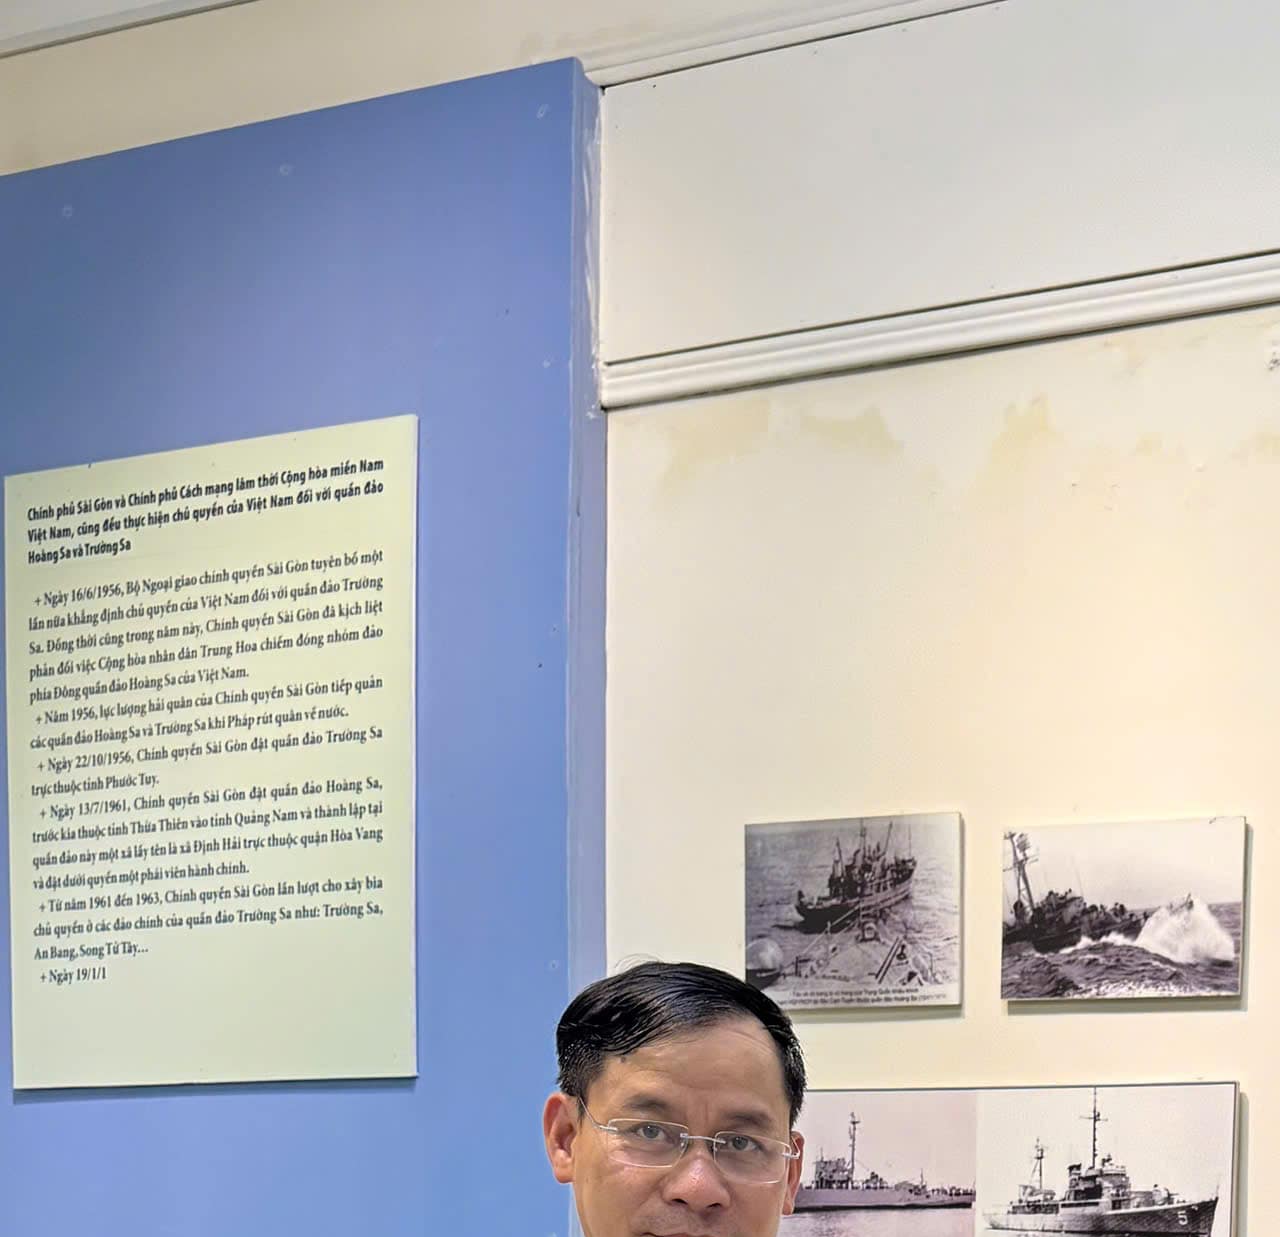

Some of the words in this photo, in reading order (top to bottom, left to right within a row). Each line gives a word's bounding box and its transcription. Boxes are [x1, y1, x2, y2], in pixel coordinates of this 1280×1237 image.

[28, 505, 54, 520] Chính
[57, 501, 75, 519] phủ
[77, 500, 92, 514] Sài
[94, 497, 112, 510] Gòn
[115, 494, 125, 508] và
[129, 491, 156, 506] Chính
[159, 486, 177, 504] phủ
[180, 483, 202, 498] Cách
[206, 482, 233, 497] mạng
[236, 477, 255, 491] lâm
[258, 474, 278, 488] thời
[281, 471, 305, 487] Cộng
[309, 466, 328, 479] hòa
[331, 461, 356, 476] miền
[360, 460, 383, 472] Nam
[28, 528, 46, 545] Việt
[50, 526, 74, 539] Nam,
[78, 521, 99, 536] cũng
[103, 518, 120, 532] đều
[124, 515, 146, 531] thực
[148, 512, 169, 528] hiện
[173, 506, 190, 521] chủ
[193, 502, 224, 522] quyền
[227, 500, 243, 514] của
[247, 498, 266, 514] Việt
[271, 495, 293, 508] Nam
[297, 489, 312, 504] đối
[317, 487, 331, 501] với
[335, 484, 360, 501] quần
[364, 480, 383, 494] đảo
[29, 549, 58, 564] Hoàng
[60, 546, 71, 560] Sa
[73, 544, 83, 557] và
[85, 541, 118, 555] Trường
[120, 538, 131, 551] Sa
[50, 969, 73, 985] Ngày
[77, 967, 106, 980] 19/1/1
[1178, 1210, 1188, 1225] 5
